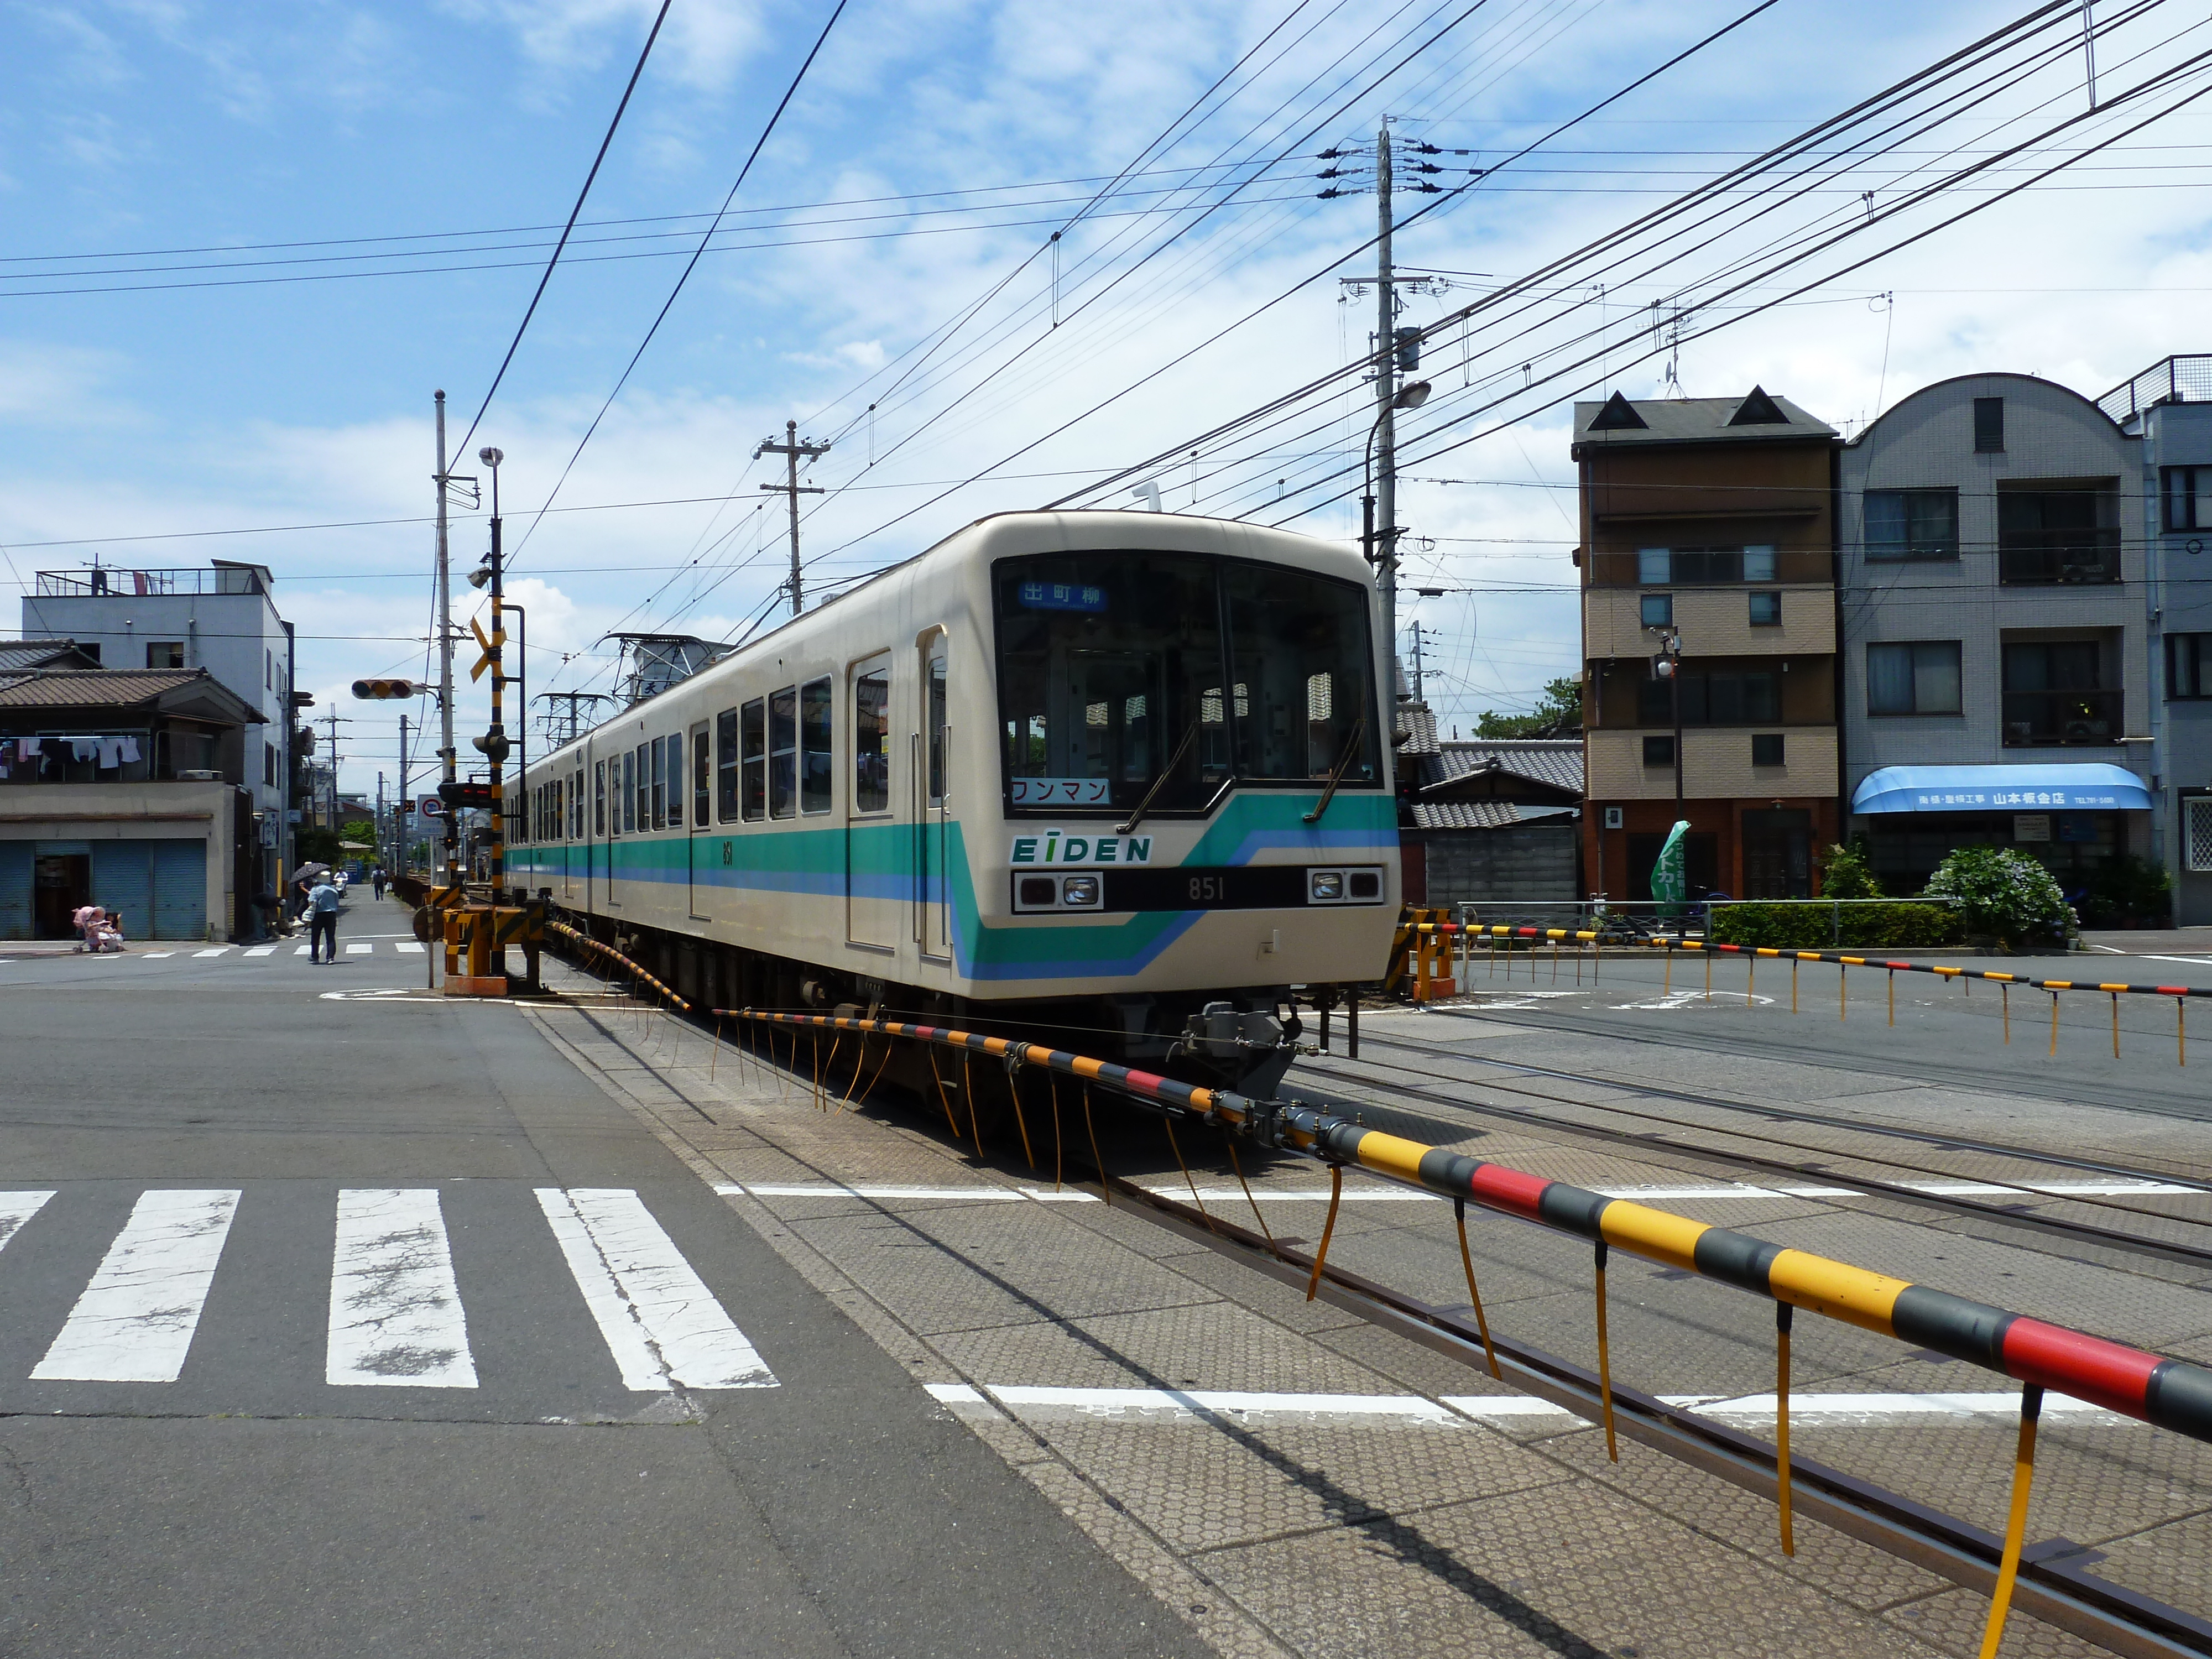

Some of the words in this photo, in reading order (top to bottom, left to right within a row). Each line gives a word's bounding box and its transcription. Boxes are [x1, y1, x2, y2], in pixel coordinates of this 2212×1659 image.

[1024, 583, 1099, 604] 出町柳
[1011, 781, 1105, 801] ワンマン
[1993, 792, 2065, 805] 山本板金店
[723, 841, 732, 866] 851
[1190, 877, 1223, 900] 851
